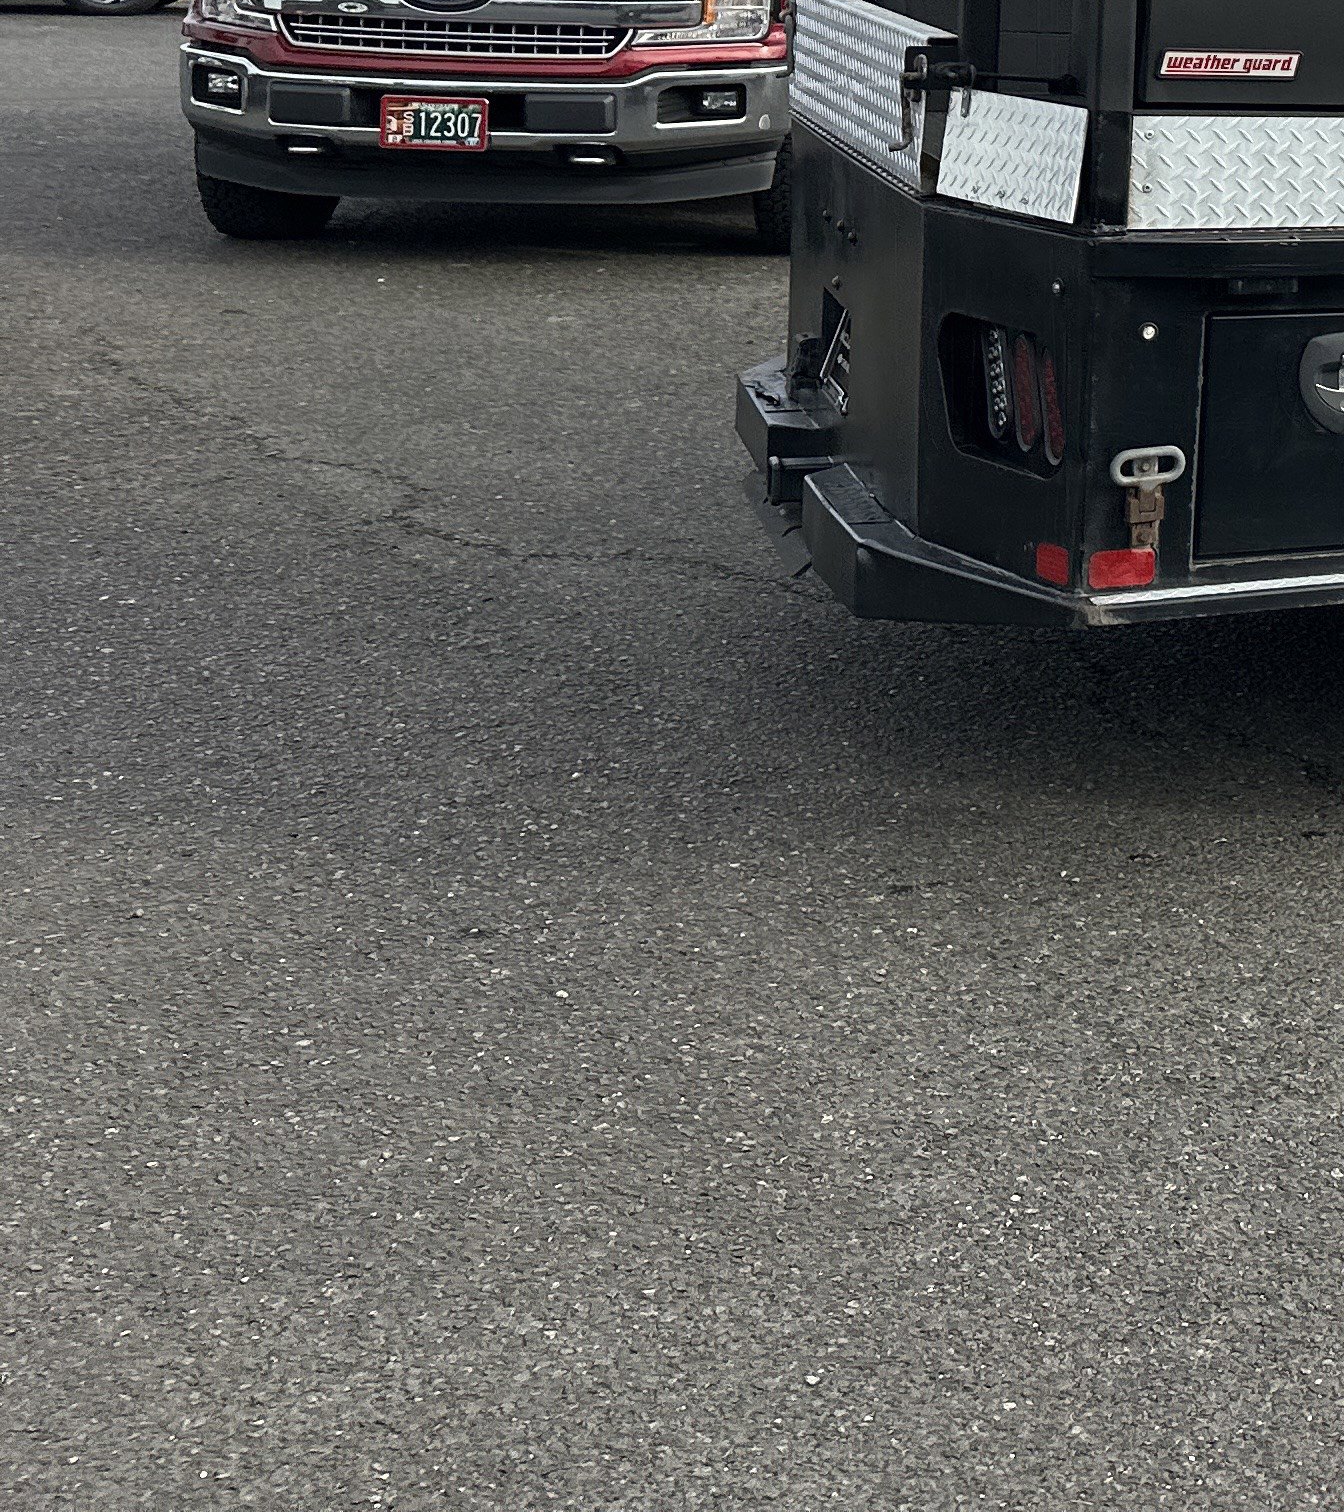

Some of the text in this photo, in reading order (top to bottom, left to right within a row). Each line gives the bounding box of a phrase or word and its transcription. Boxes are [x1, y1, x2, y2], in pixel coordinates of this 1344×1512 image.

[1166, 54, 1293, 74] weather guard
[419, 111, 482, 138] 12307
